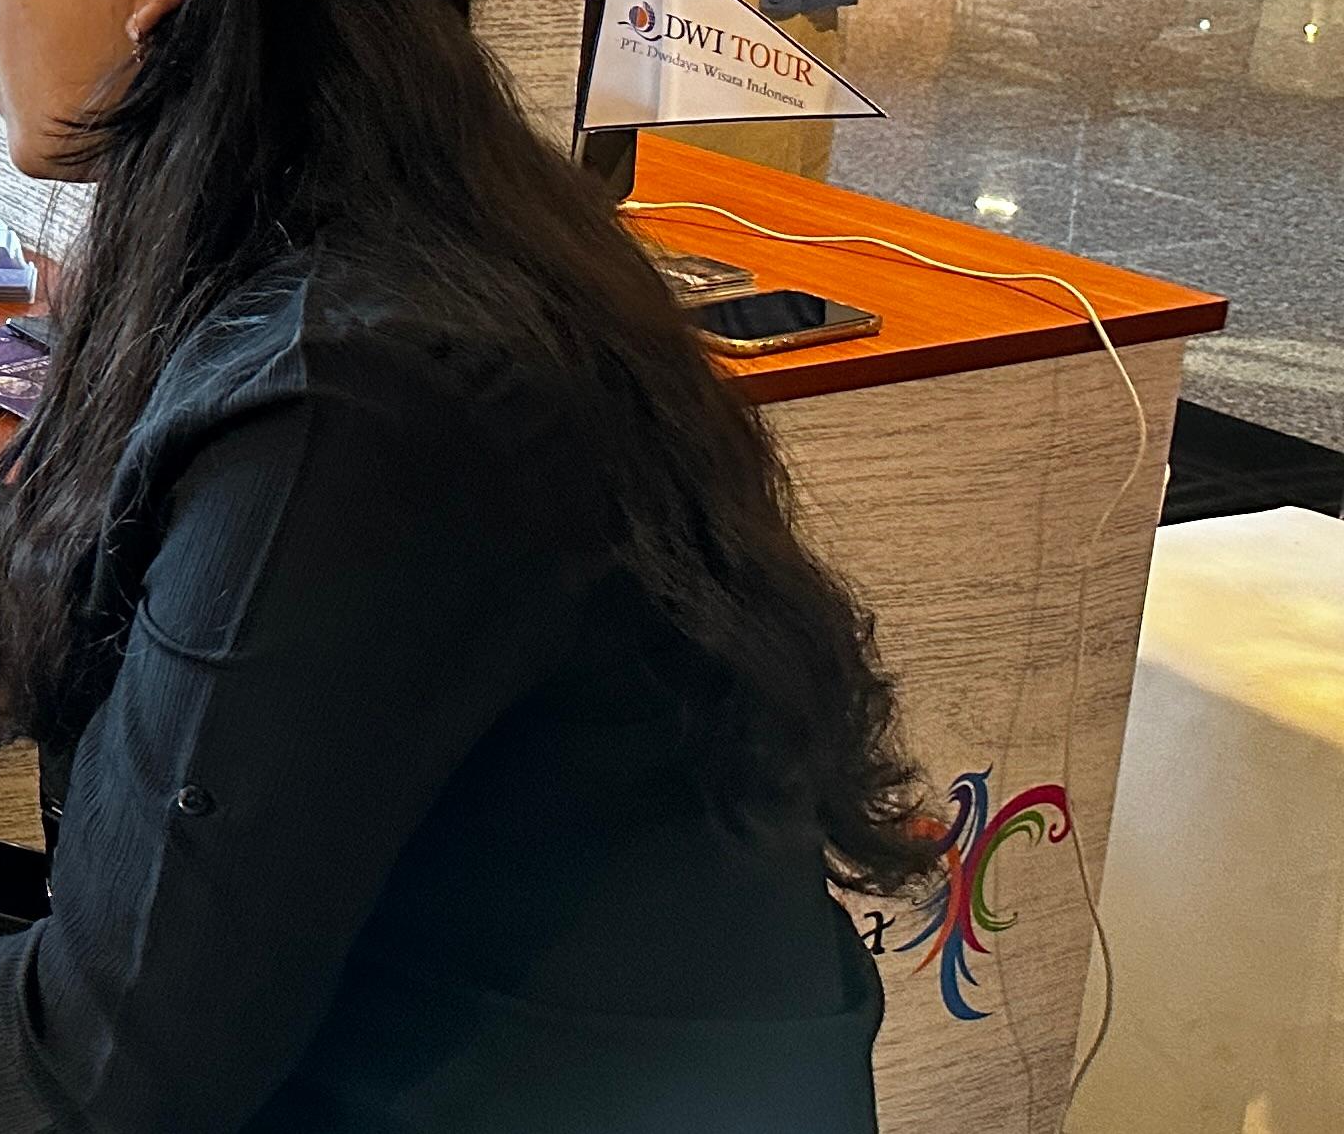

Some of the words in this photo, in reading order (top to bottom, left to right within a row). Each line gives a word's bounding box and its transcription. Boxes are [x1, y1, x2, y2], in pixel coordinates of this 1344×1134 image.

[647, 44, 700, 73] Dwidaya
[703, 62, 744, 88] Wisata
[746, 77, 804, 109] Indonesia
[665, 14, 725, 54] DWI
[730, 35, 814, 86] TOUR
